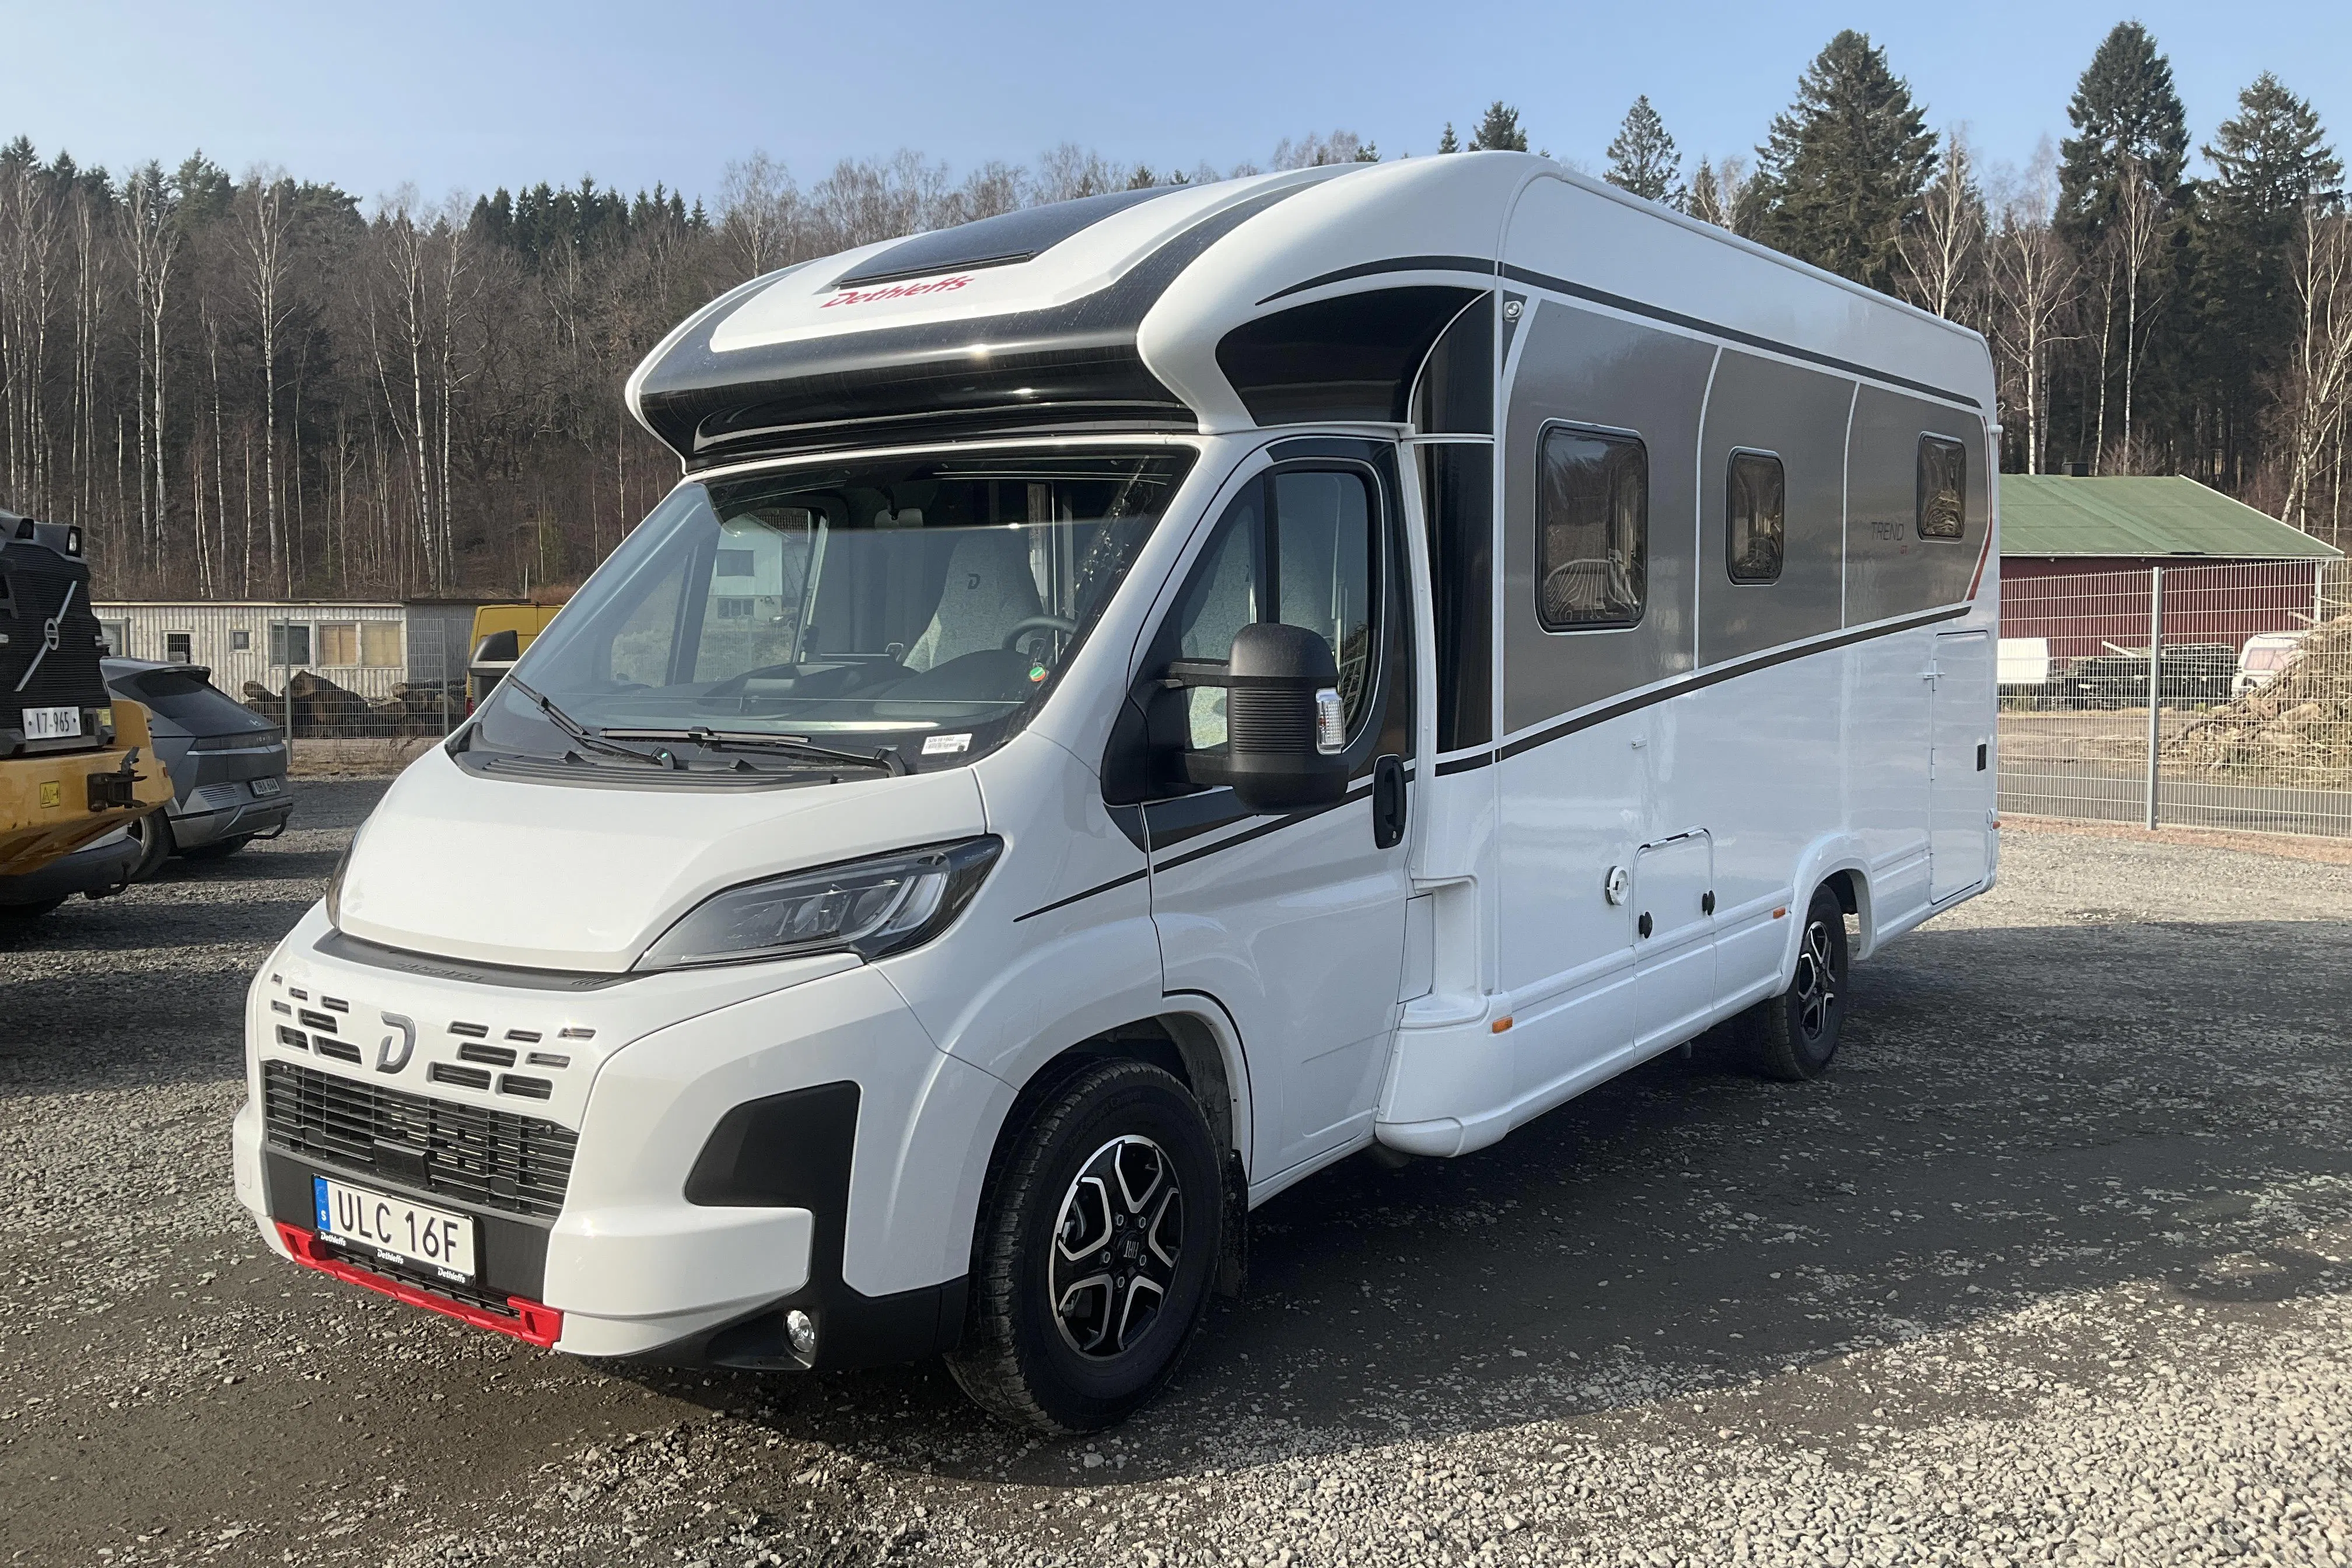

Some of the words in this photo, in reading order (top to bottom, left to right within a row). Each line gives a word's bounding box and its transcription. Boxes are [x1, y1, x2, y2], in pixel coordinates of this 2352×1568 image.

[819, 275, 975, 309] Dethleffs
[1871, 522, 1904, 541] TREND
[36, 711, 69, 733] 17-965
[321, 1210, 327, 1222] S
[338, 1190, 392, 1244] ULC
[405, 1210, 459, 1263] 16F
[320, 1231, 346, 1247] Dethleffs
[377, 1248, 404, 1264] Dethleffs
[1124, 1240, 1139, 1258] FIAT
[438, 1266, 466, 1283] Dethleffs
